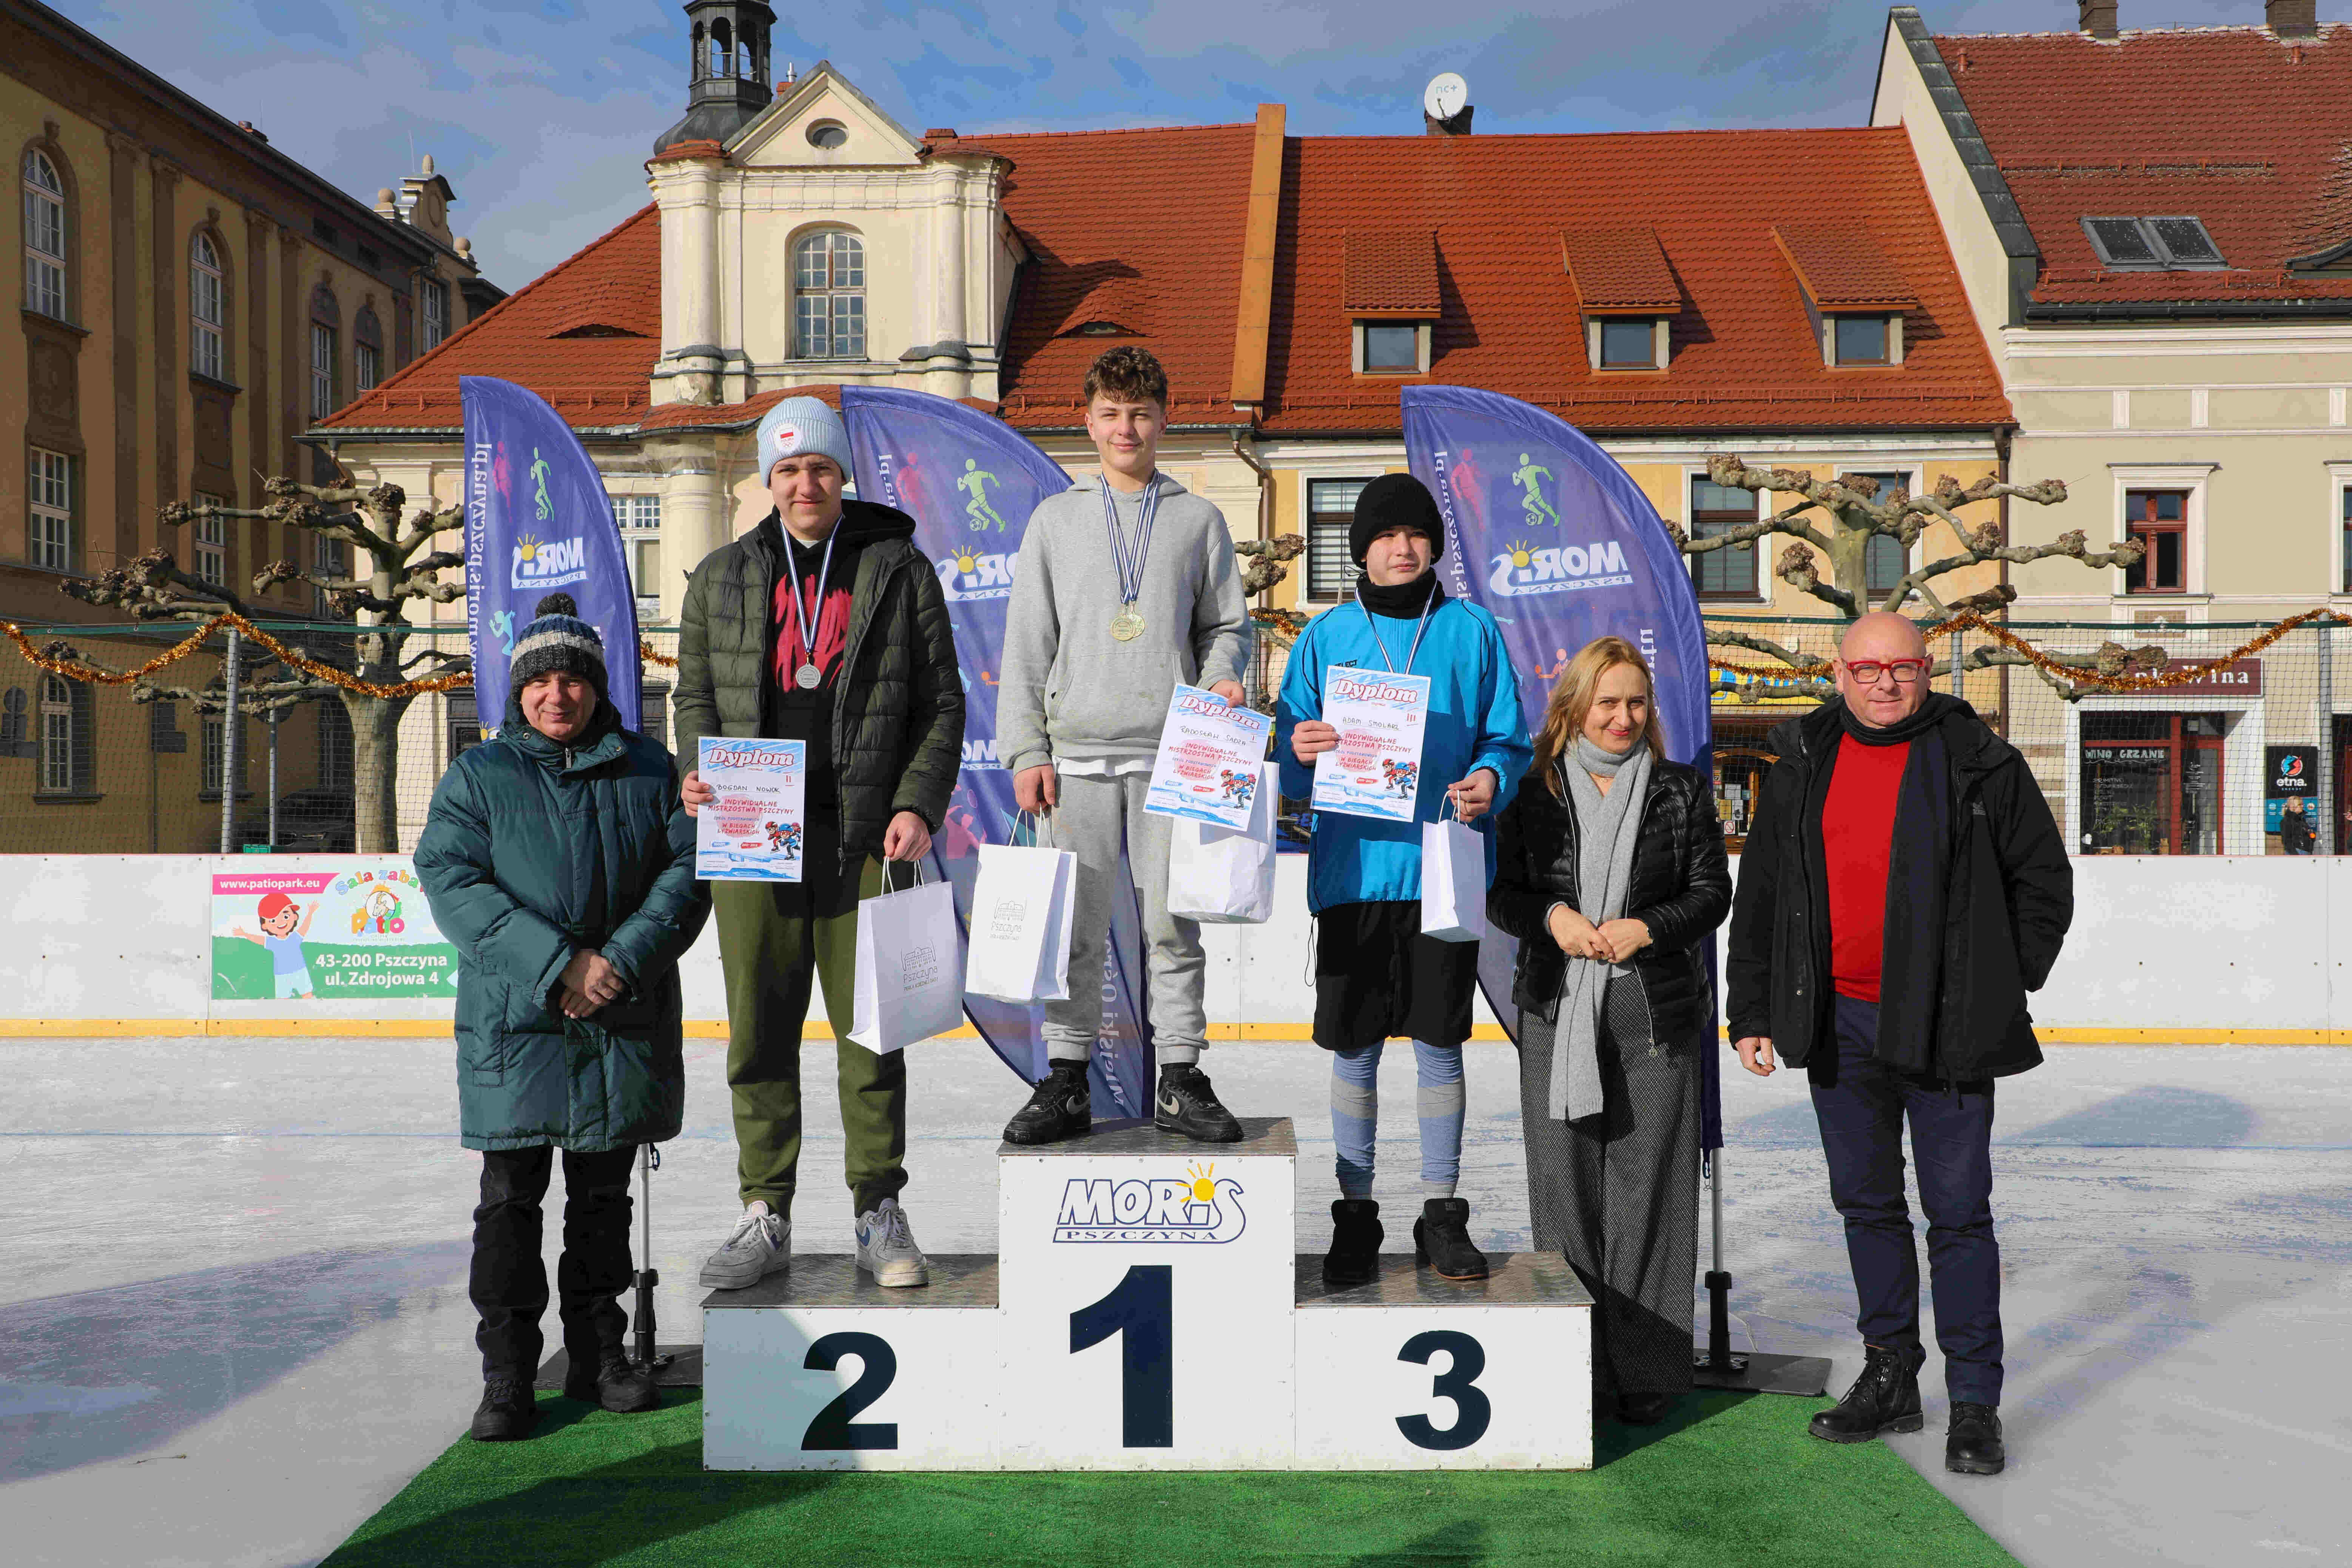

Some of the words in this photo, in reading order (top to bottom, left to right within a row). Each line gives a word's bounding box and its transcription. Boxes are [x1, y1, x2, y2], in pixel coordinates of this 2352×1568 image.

[1335, 679, 1417, 703] Dyplom
[1180, 695, 1260, 730] Dyplom
[1336, 739, 1375, 749] STRZOSTWA
[1377, 743, 1412, 753] PSZCZYNY
[1345, 732, 1397, 745] INDYWIDUALNE
[1168, 746, 1215, 760] MISTRZOSTWA
[1217, 755, 1254, 766] PSZCZYNY
[1185, 742, 1238, 756] INDYWIDUALNE
[2085, 749, 2112, 759] WINO
[2119, 749, 2164, 759] GRZANE
[709, 748, 794, 768] Dyplom
[1185, 765, 1211, 774] BIEGACH
[707, 804, 756, 813] MISTRZOSTWA
[724, 798, 778, 807] INDYWIDUALNE
[220, 878, 320, 891] www.patiopark.eu
[336, 871, 374, 895] Sala
[379, 870, 423, 892] zaba
[316, 954, 372, 967] 43-200
[375, 953, 447, 970] Pszczyna
[325, 971, 345, 985] ul.
[348, 971, 425, 989] Zdrojowa
[428, 971, 439, 984] 4
[903, 965, 938, 984] Pszczyna
[1066, 1231, 1219, 1241] PSZCZYNA
[1069, 1264, 1173, 1448] 1
[801, 1331, 898, 1451] 2
[1395, 1329, 1491, 1451] 3
